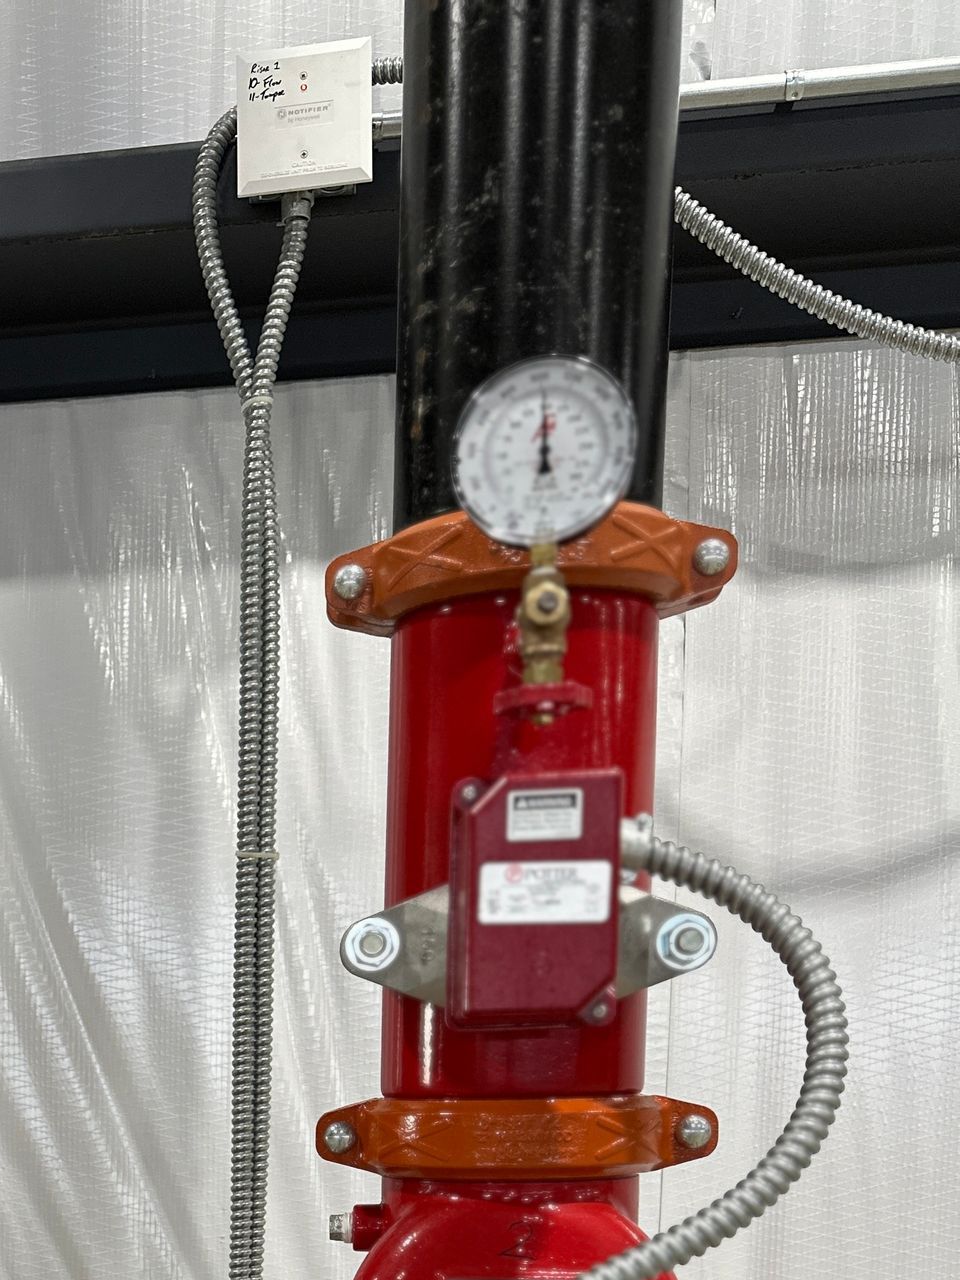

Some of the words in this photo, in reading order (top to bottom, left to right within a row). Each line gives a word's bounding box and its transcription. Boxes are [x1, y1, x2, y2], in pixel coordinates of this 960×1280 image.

[274, 62, 280, 70] 1
[264, 75, 282, 88] Flow
[288, 106, 328, 116] NOTIFIER
[497, 1220, 537, 1260] 2
